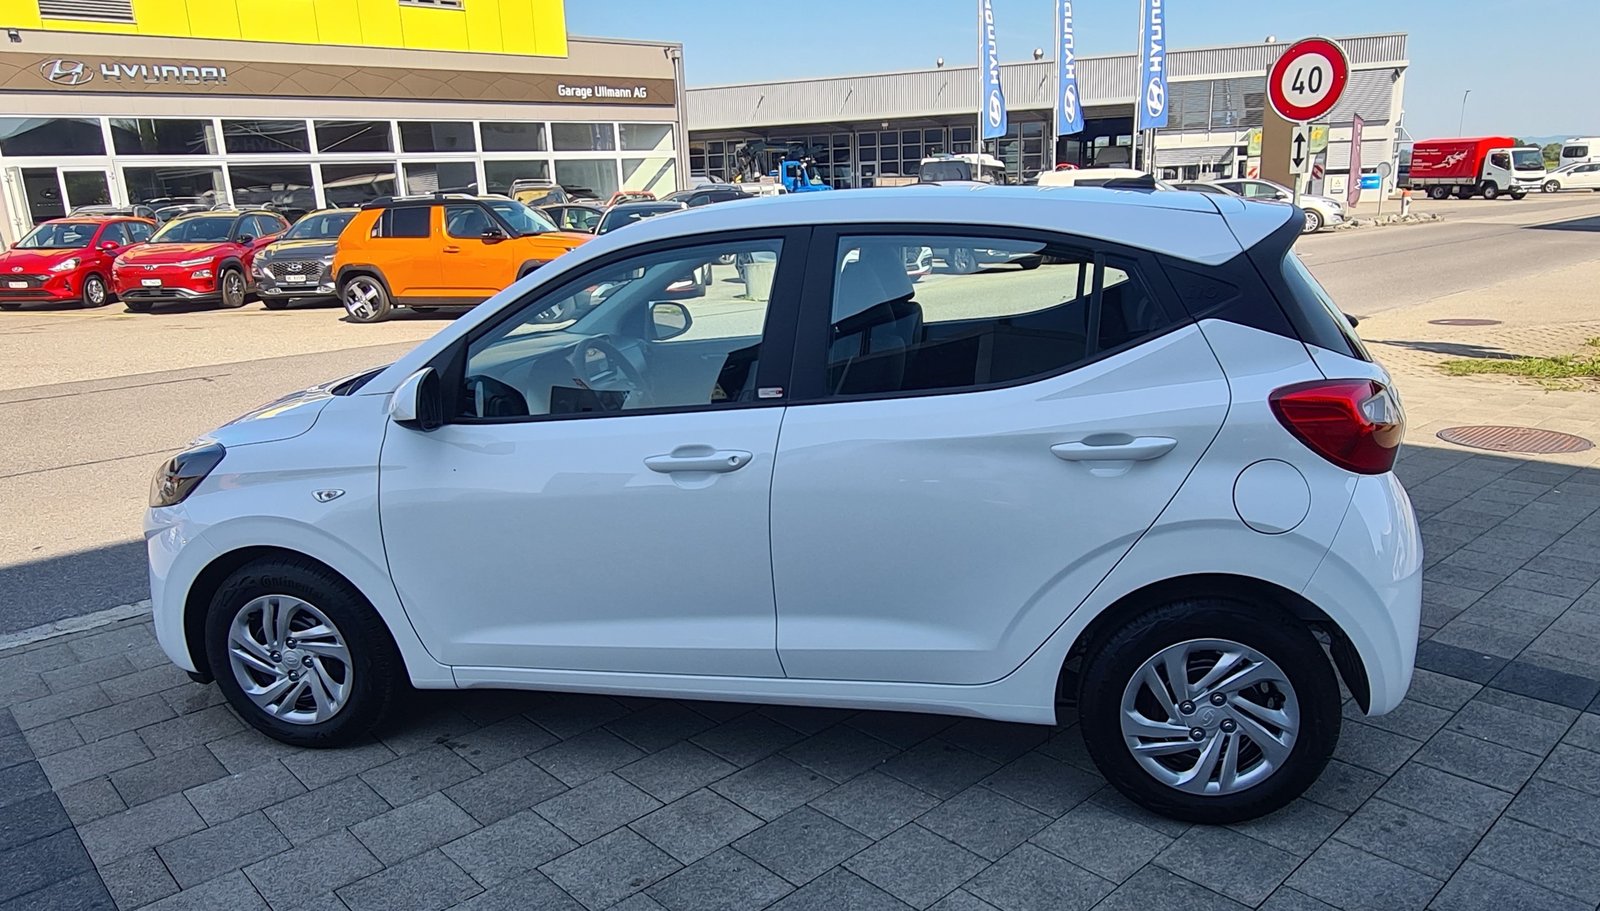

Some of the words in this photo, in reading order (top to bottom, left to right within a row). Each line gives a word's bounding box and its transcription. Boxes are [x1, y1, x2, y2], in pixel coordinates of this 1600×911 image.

[100, 62, 228, 86] HYUNDAI
[1291, 65, 1323, 95] 40
[557, 84, 593, 99] Garage
[594, 85, 632, 98] Ullmann
[633, 87, 647, 98] AG
